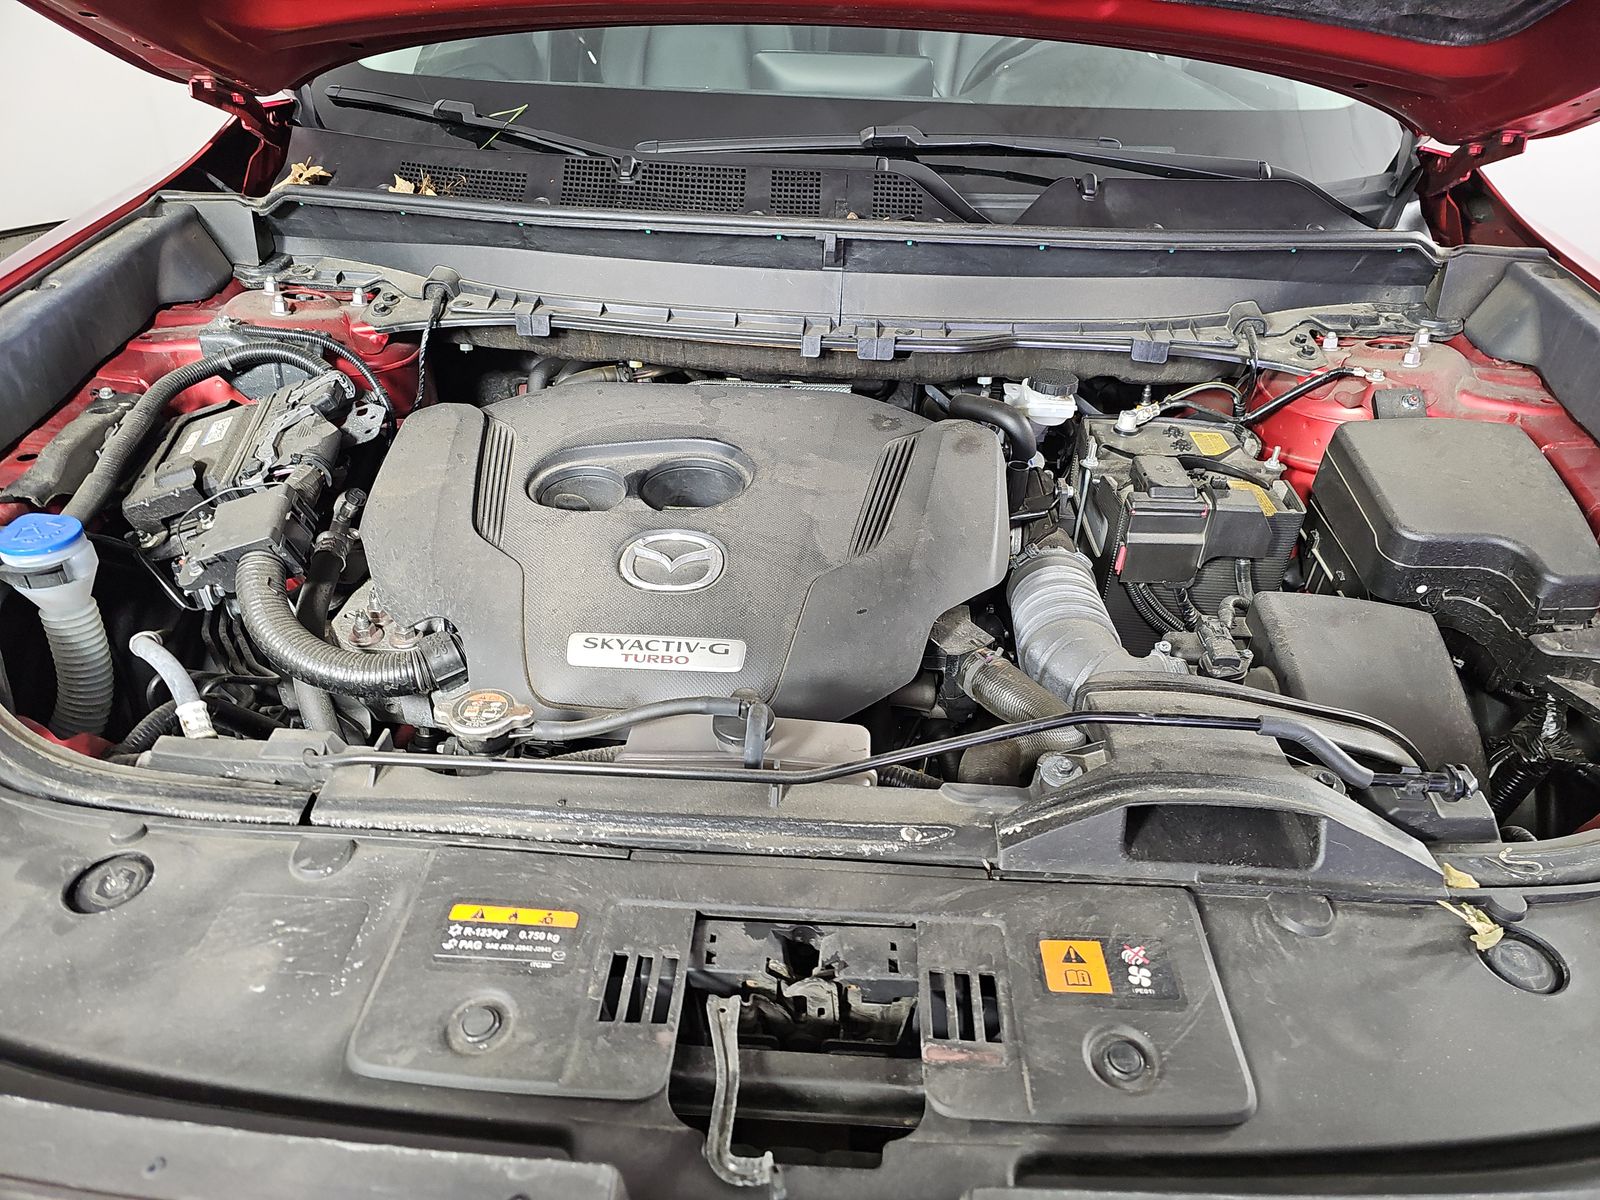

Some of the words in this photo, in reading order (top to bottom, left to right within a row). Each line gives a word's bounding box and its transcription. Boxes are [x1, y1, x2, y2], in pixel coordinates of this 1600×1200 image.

[583, 637, 730, 655] SKYACTIV-G
[621, 653, 690, 665] TURBO
[519, 930, 546, 941] 0.750
[547, 932, 560, 943] kg
[458, 939, 482, 950] PAG
